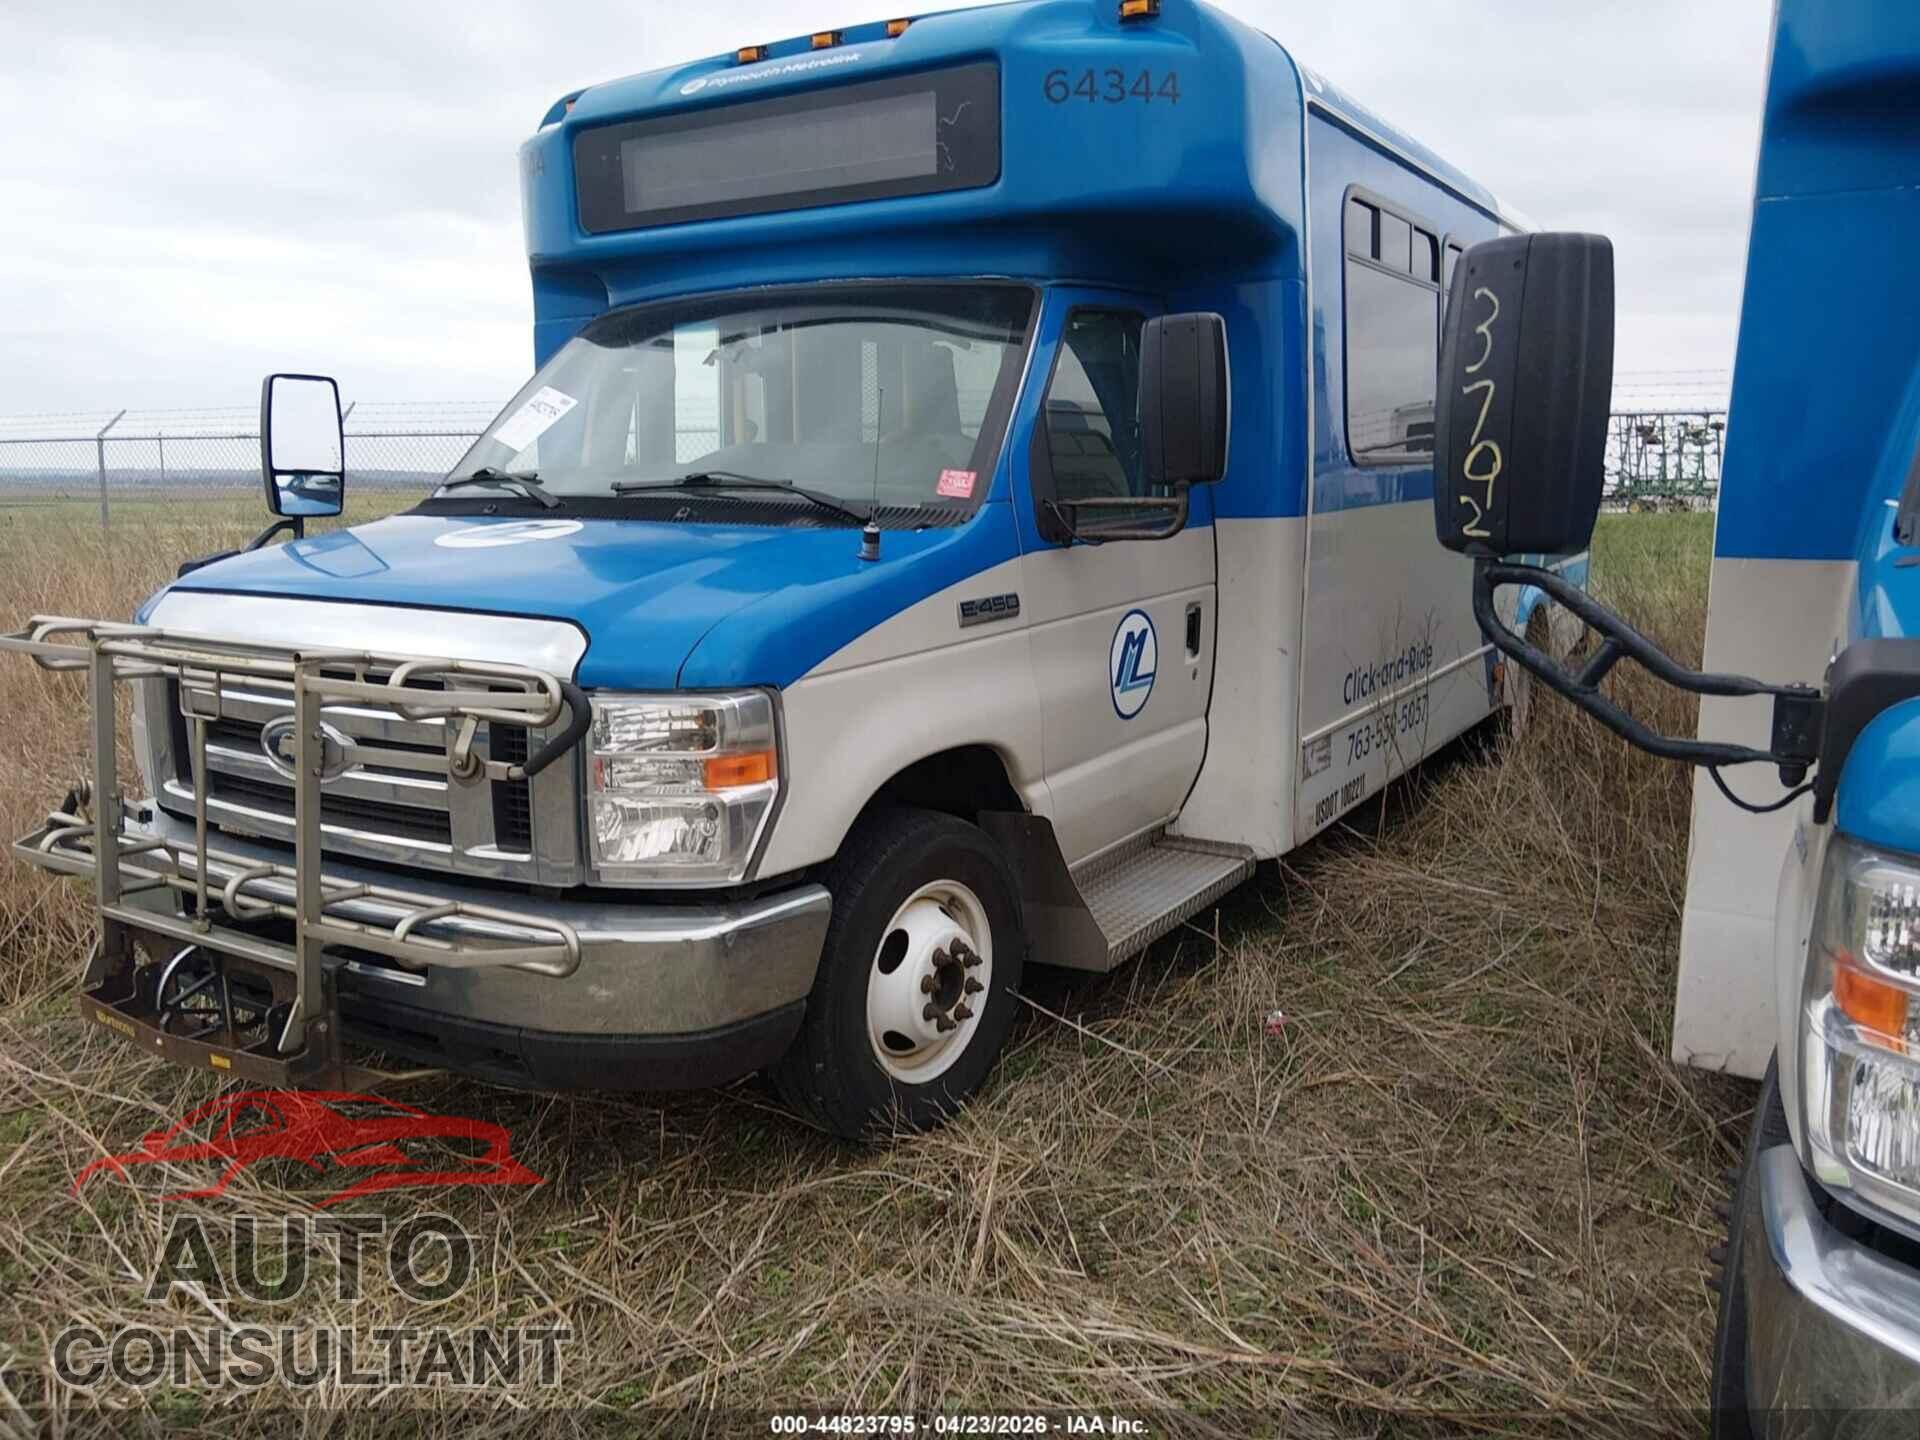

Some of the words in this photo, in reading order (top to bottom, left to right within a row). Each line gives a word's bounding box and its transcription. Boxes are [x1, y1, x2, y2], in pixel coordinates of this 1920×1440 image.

[1044, 68, 1181, 105] 64344
[1459, 287, 1502, 537] 3792
[960, 593, 1020, 617] E-450
[1343, 645, 1432, 705] Click-and-Ride
[1315, 789, 1339, 827] USDOT
